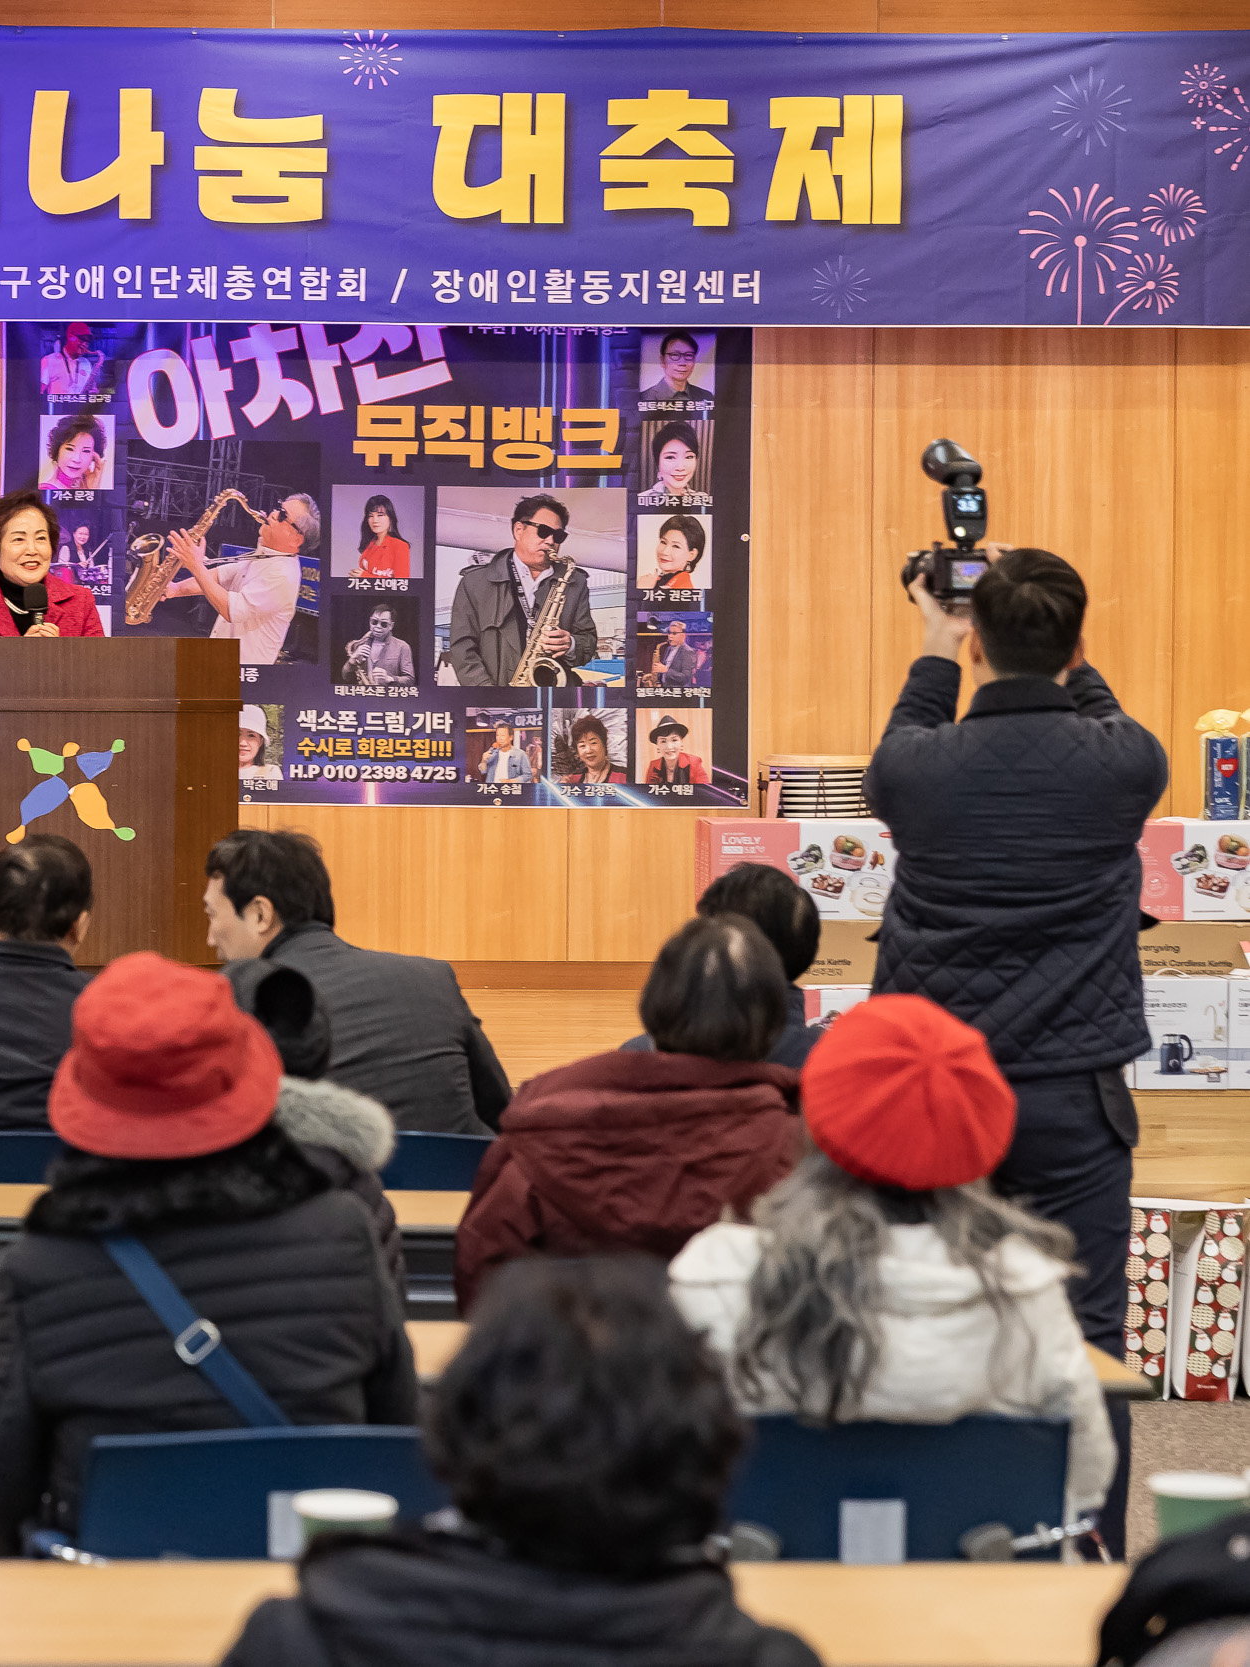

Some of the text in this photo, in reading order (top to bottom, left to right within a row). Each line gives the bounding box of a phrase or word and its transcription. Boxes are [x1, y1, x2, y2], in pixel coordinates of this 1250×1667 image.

[432, 89, 903, 227] 대축제
[431, 268, 762, 304] 장애인활동지원센터
[127, 323, 453, 450] 아차산
[352, 404, 623, 471] 뮤직뱅크
[52, 490, 73, 501] 가수
[347, 578, 409, 592] 가수 신애정
[642, 590, 666, 602] 가수
[334, 685, 386, 697] 테너색소폰
[296, 709, 453, 736] 색소폰,드럼,기타
[297, 737, 452, 759] 수시로 회원모집!!!
[289, 764, 456, 781] H.P 010 2398 4725
[476, 783, 522, 795] 가수 송철
[560, 785, 583, 797] 가수
[648, 784, 694, 796] 가수 예원
